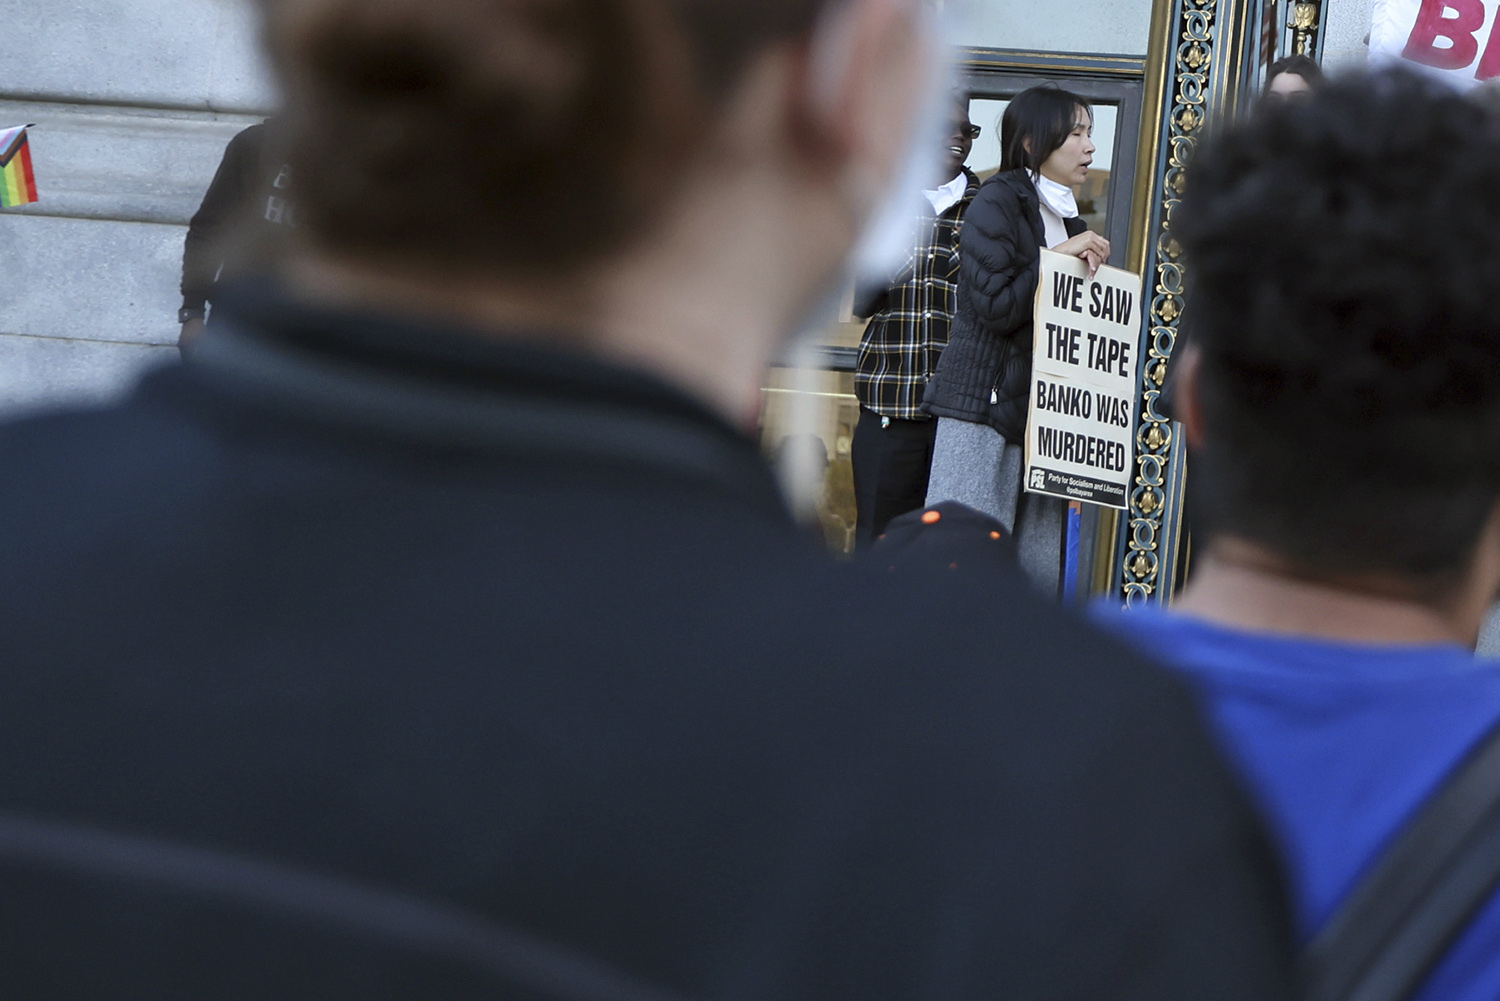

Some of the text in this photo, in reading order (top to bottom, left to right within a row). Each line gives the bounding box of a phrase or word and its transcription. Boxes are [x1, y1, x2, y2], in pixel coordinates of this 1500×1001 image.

[1053, 270, 1133, 326] WE SAW
[1045, 322, 1131, 378] THE TAPE
[1036, 379, 1129, 429] BANKO WAS
[1037, 425, 1126, 473] MURDERED
[1030, 473, 1046, 490] PSL
[1048, 472, 1125, 496] Party for Socialism and Liberation
